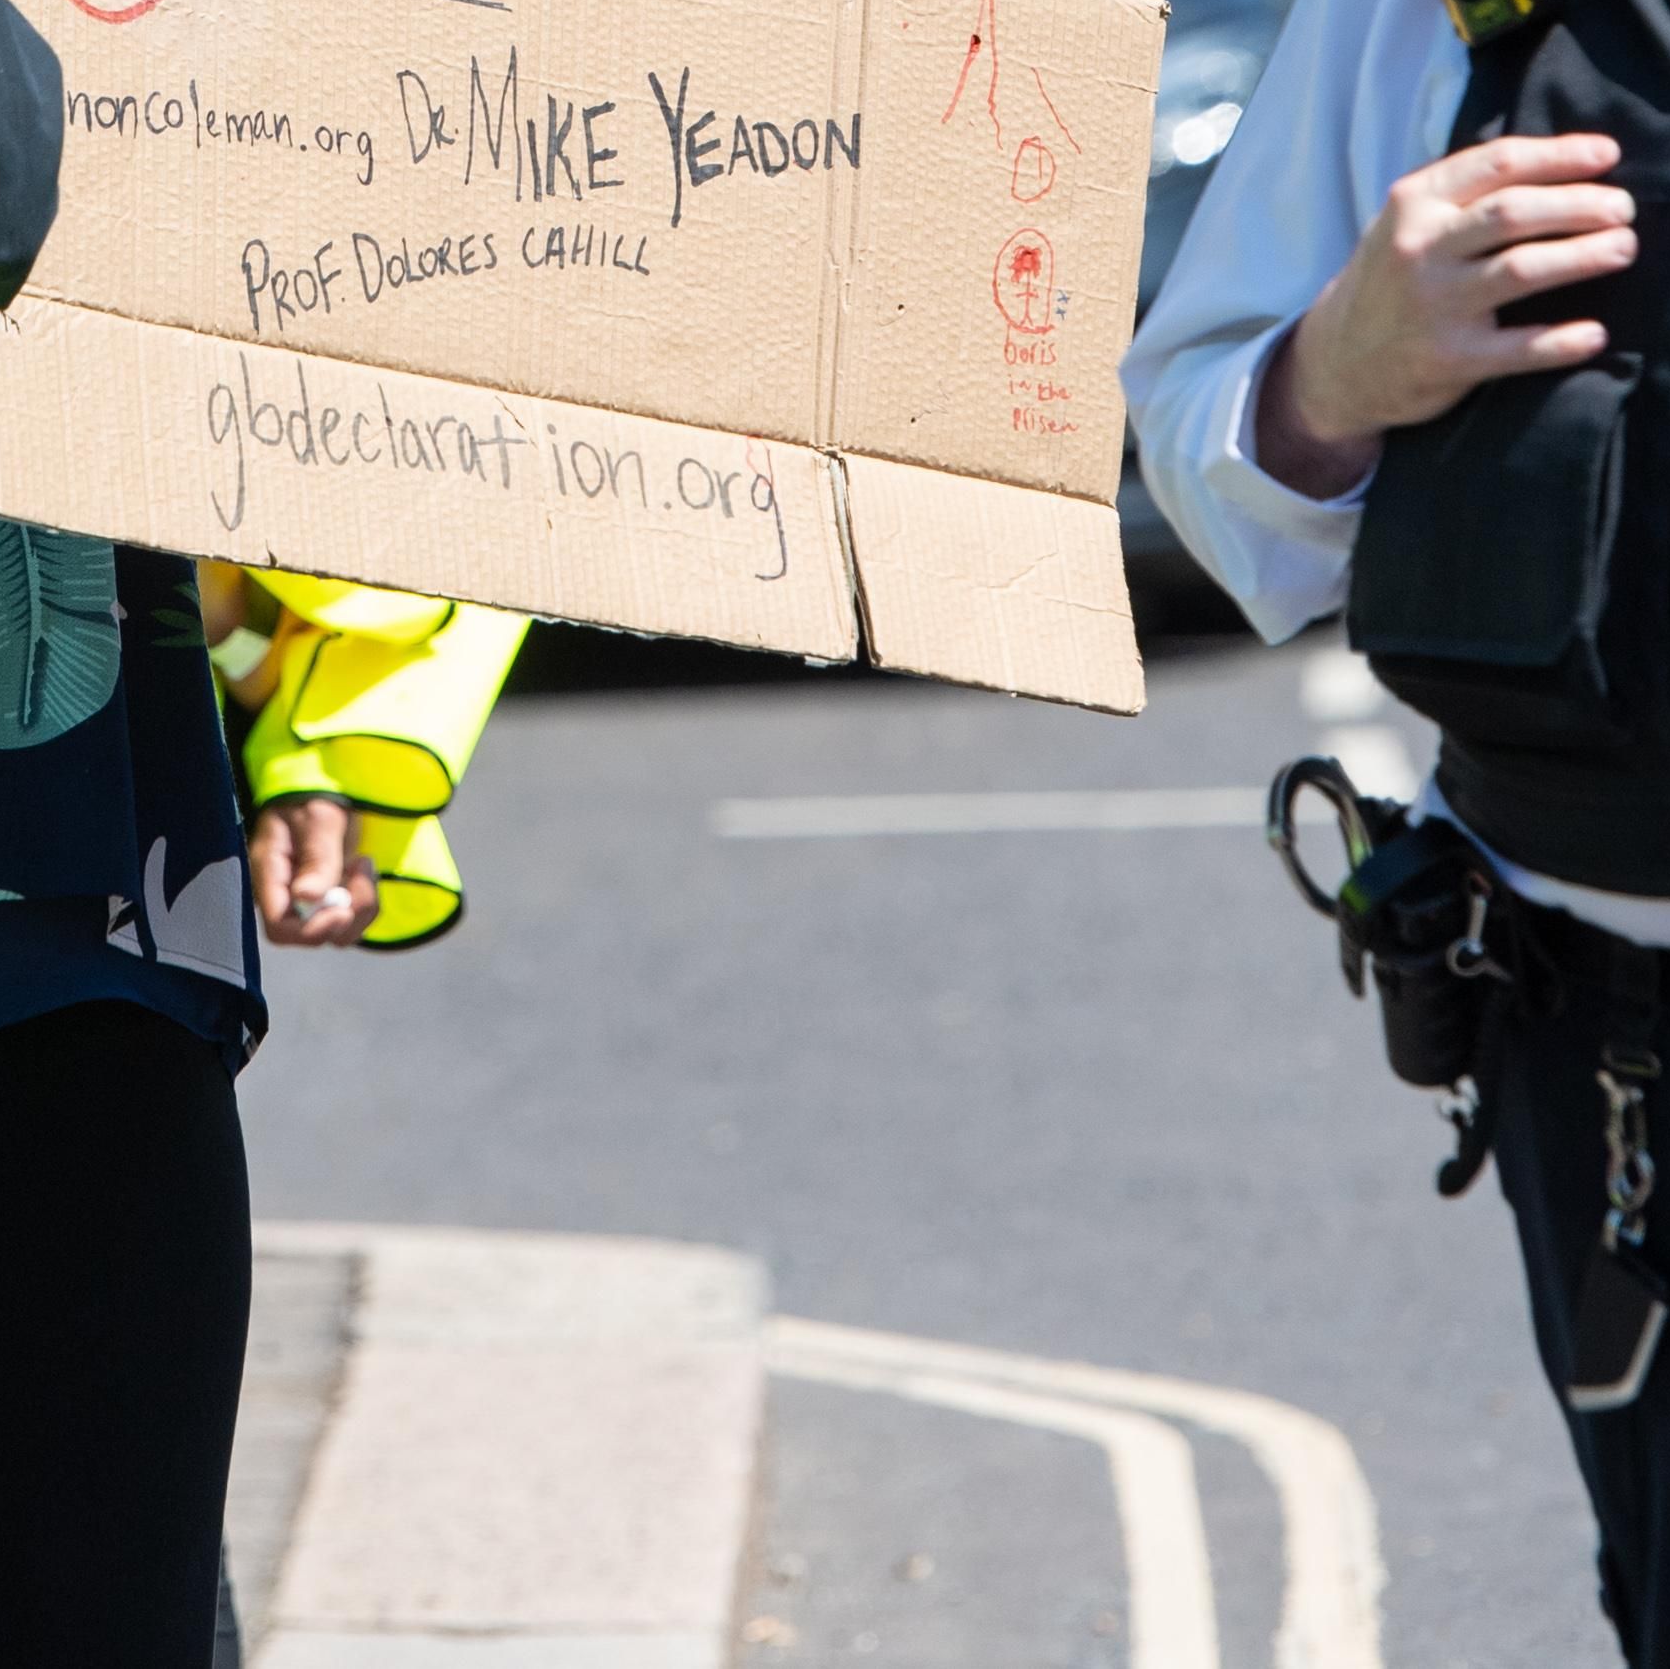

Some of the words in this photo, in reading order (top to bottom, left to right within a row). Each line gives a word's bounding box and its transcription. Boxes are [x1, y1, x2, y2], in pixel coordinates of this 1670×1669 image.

[66, 78, 374, 186] noncoleman.org
[464, 44, 625, 203] MIKE
[647, 65, 861, 228] YEADON
[240, 238, 347, 335] PROF.
[351, 232, 498, 304] DOLORES
[521, 223, 651, 277] CAHILL
[206, 349, 789, 582] gbdeclaration.org
